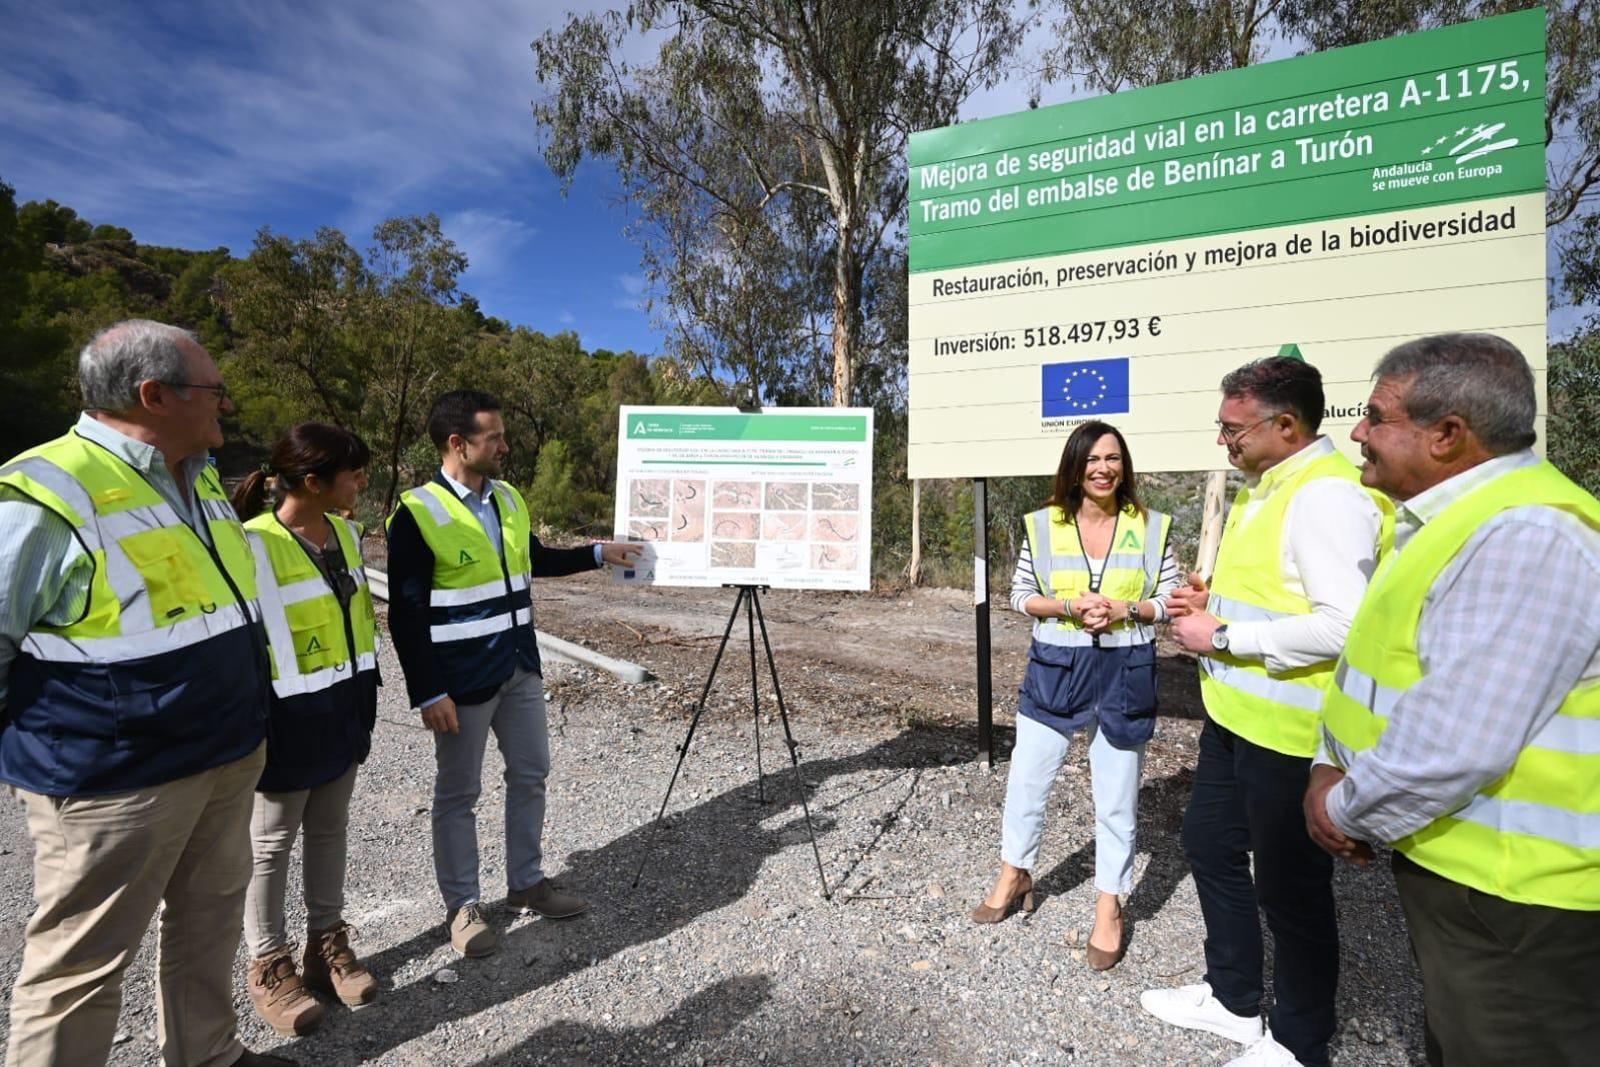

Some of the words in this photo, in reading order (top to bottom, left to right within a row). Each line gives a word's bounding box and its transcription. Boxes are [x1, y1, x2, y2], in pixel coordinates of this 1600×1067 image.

[920, 162, 987, 190] Mejora
[996, 153, 1020, 177] de
[1028, 135, 1135, 173] seguridad
[1145, 121, 1186, 150] vial
[1195, 119, 1224, 143] en
[1235, 111, 1256, 136] la
[1267, 91, 1388, 131] carretera
[1400, 60, 1530, 108] A-1175,
[920, 197, 981, 223] Tramo
[989, 186, 1019, 212] del
[1027, 173, 1118, 206] embalse
[1127, 166, 1155, 191] de
[1165, 151, 1261, 187] Benínar
[1271, 150, 1285, 169] a
[1296, 131, 1373, 165] Turón
[1372, 181, 1386, 191] se
[1388, 175, 1429, 189] mueve
[1432, 171, 1454, 182] con
[1458, 164, 1503, 179] Europa
[1373, 160, 1433, 179] Andalucía
[933, 267, 1049, 296] Restauración,
[1057, 250, 1178, 286] preservación
[1185, 251, 1197, 273] y
[1204, 240, 1277, 268] mejora
[1286, 234, 1312, 255] de
[1321, 230, 1340, 251] la
[1350, 206, 1516, 248] biodiversidad
[934, 331, 1016, 356] Inversión:
[1024, 318, 1140, 347] 518.497,93
[1148, 316, 1162, 336] €
[1041, 419, 1065, 427] UNIÓN
